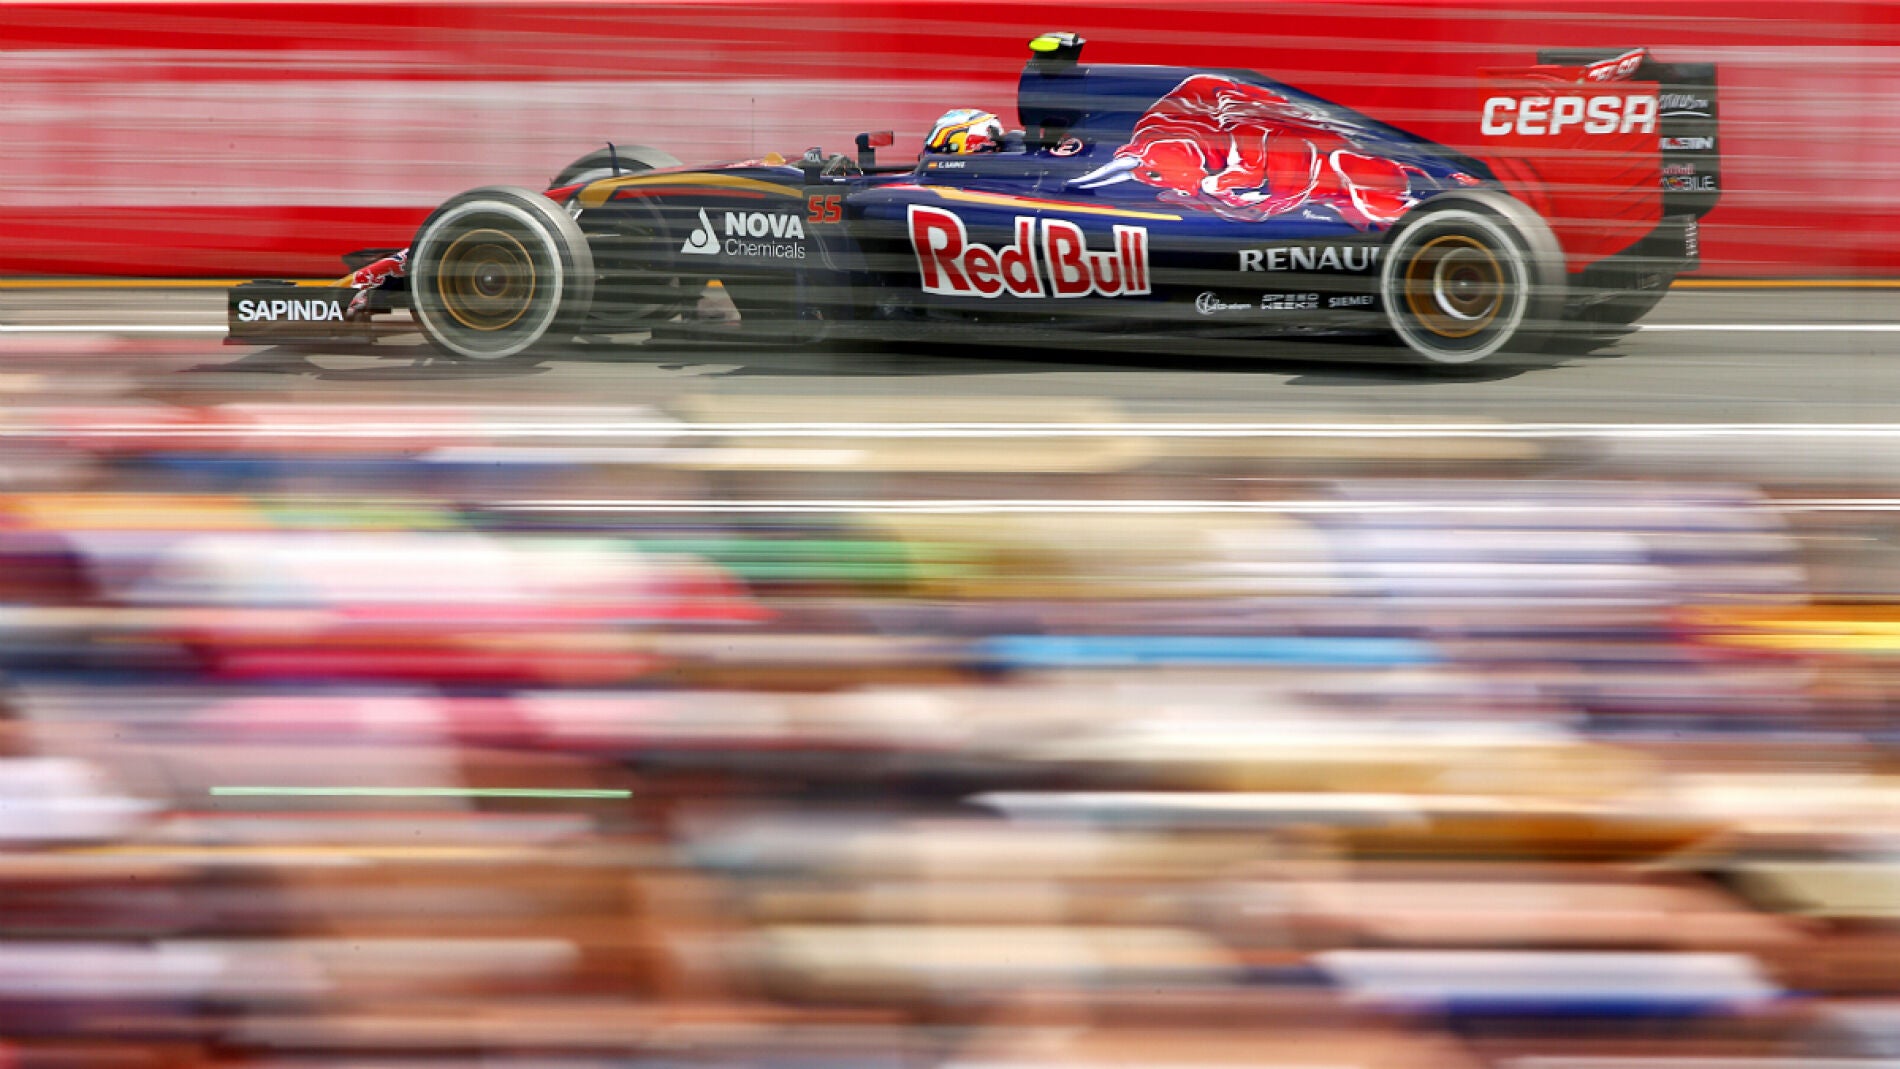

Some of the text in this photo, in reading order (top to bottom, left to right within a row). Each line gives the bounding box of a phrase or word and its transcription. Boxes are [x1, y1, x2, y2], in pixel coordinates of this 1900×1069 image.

[1481, 95, 1658, 135] CEPSA
[807, 195, 842, 224] 55
[725, 212, 805, 239] NOVA
[725, 239, 806, 259] Chemicals
[907, 204, 1151, 298] Red Bull
[238, 300, 344, 321] SAPINDA
